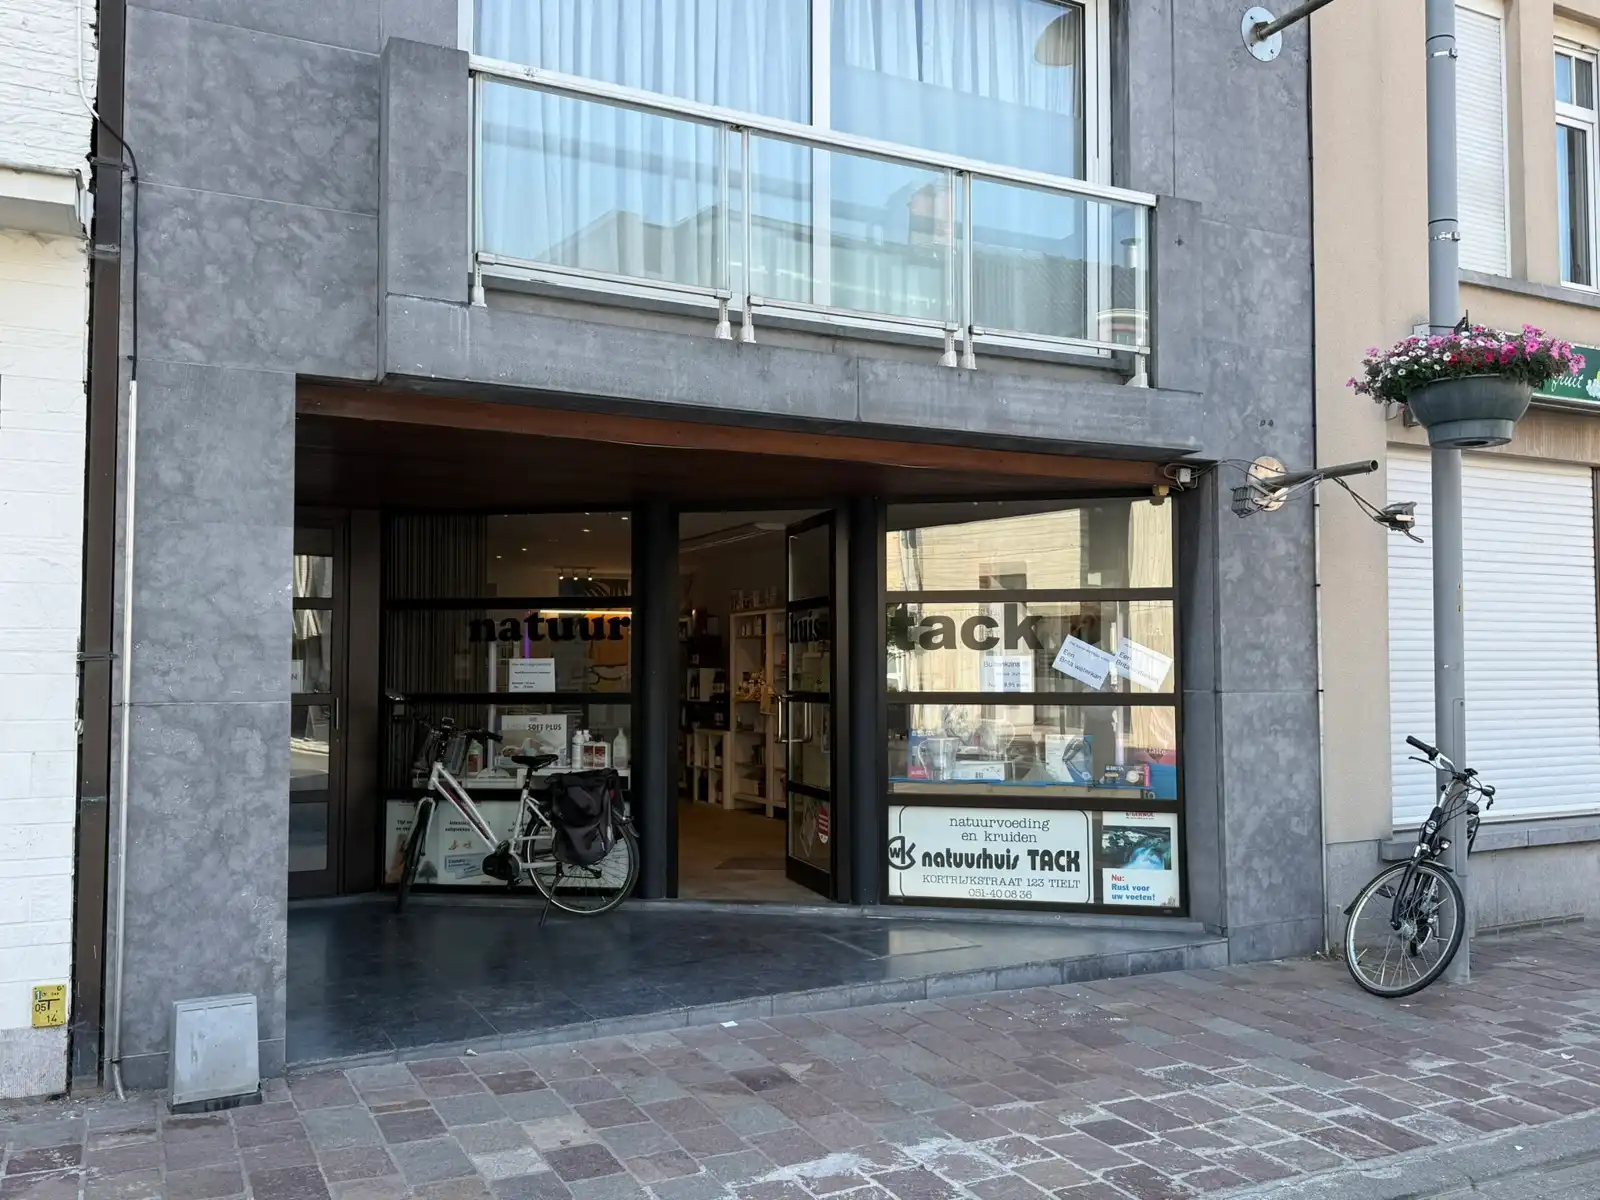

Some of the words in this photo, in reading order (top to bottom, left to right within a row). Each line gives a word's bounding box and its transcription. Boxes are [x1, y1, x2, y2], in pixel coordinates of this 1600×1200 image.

[469, 612, 630, 641] natuur
[789, 611, 818, 643] huis
[890, 603, 1043, 650] tack
[1063, 648, 1076, 659] Een
[1119, 651, 1132, 662] Een
[1059, 656, 1074, 668] Brita
[1074, 664, 1102, 681] waterkan
[1115, 659, 1130, 671] Brita
[528, 723, 543, 734] SOFT
[546, 724, 562, 734] PLUS
[949, 816, 1050, 831] natuurvoeding
[961, 831, 977, 841] en
[984, 830, 1037, 843] kruiden
[921, 848, 1020, 870] natuurhuis
[1026, 849, 1081, 872] TACK
[922, 874, 1022, 887] KORTRIJKSTRAAT
[1026, 877, 1045, 887] 123
[1048, 879, 1081, 889] TIELT
[1111, 874, 1125, 882] Nu:
[1111, 883, 1130, 891] Rust
[1126, 893, 1156, 901] voeten!
[35, 1004, 46, 1012] 05
[47, 1014, 57, 1023] 14
